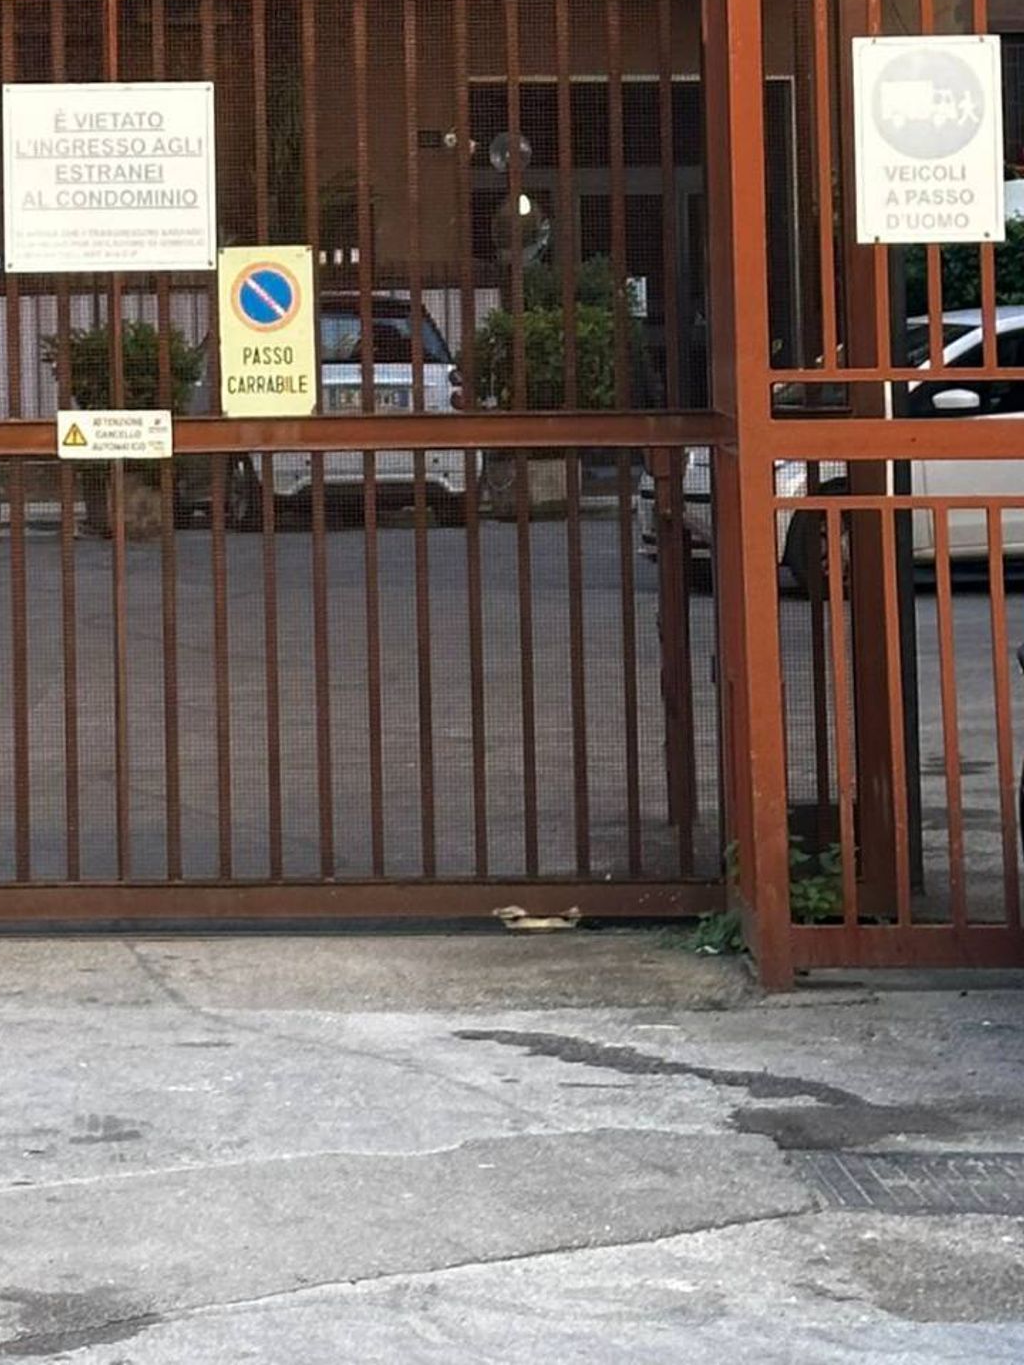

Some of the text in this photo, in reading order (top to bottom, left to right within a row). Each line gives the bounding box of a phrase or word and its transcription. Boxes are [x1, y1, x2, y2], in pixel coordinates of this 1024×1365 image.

[73, 111, 164, 128] VIETATO
[15, 136, 203, 156] L'INGRESSO AGLI
[55, 164, 164, 181] ESTRANEI
[884, 165, 967, 182] VEICOLI
[22, 189, 198, 208] AL CONDOMINIO
[885, 188, 975, 206] A PASSO
[887, 213, 970, 230] D'UOMO
[242, 346, 294, 365] PASSO
[227, 375, 308, 394] CARRABILE
